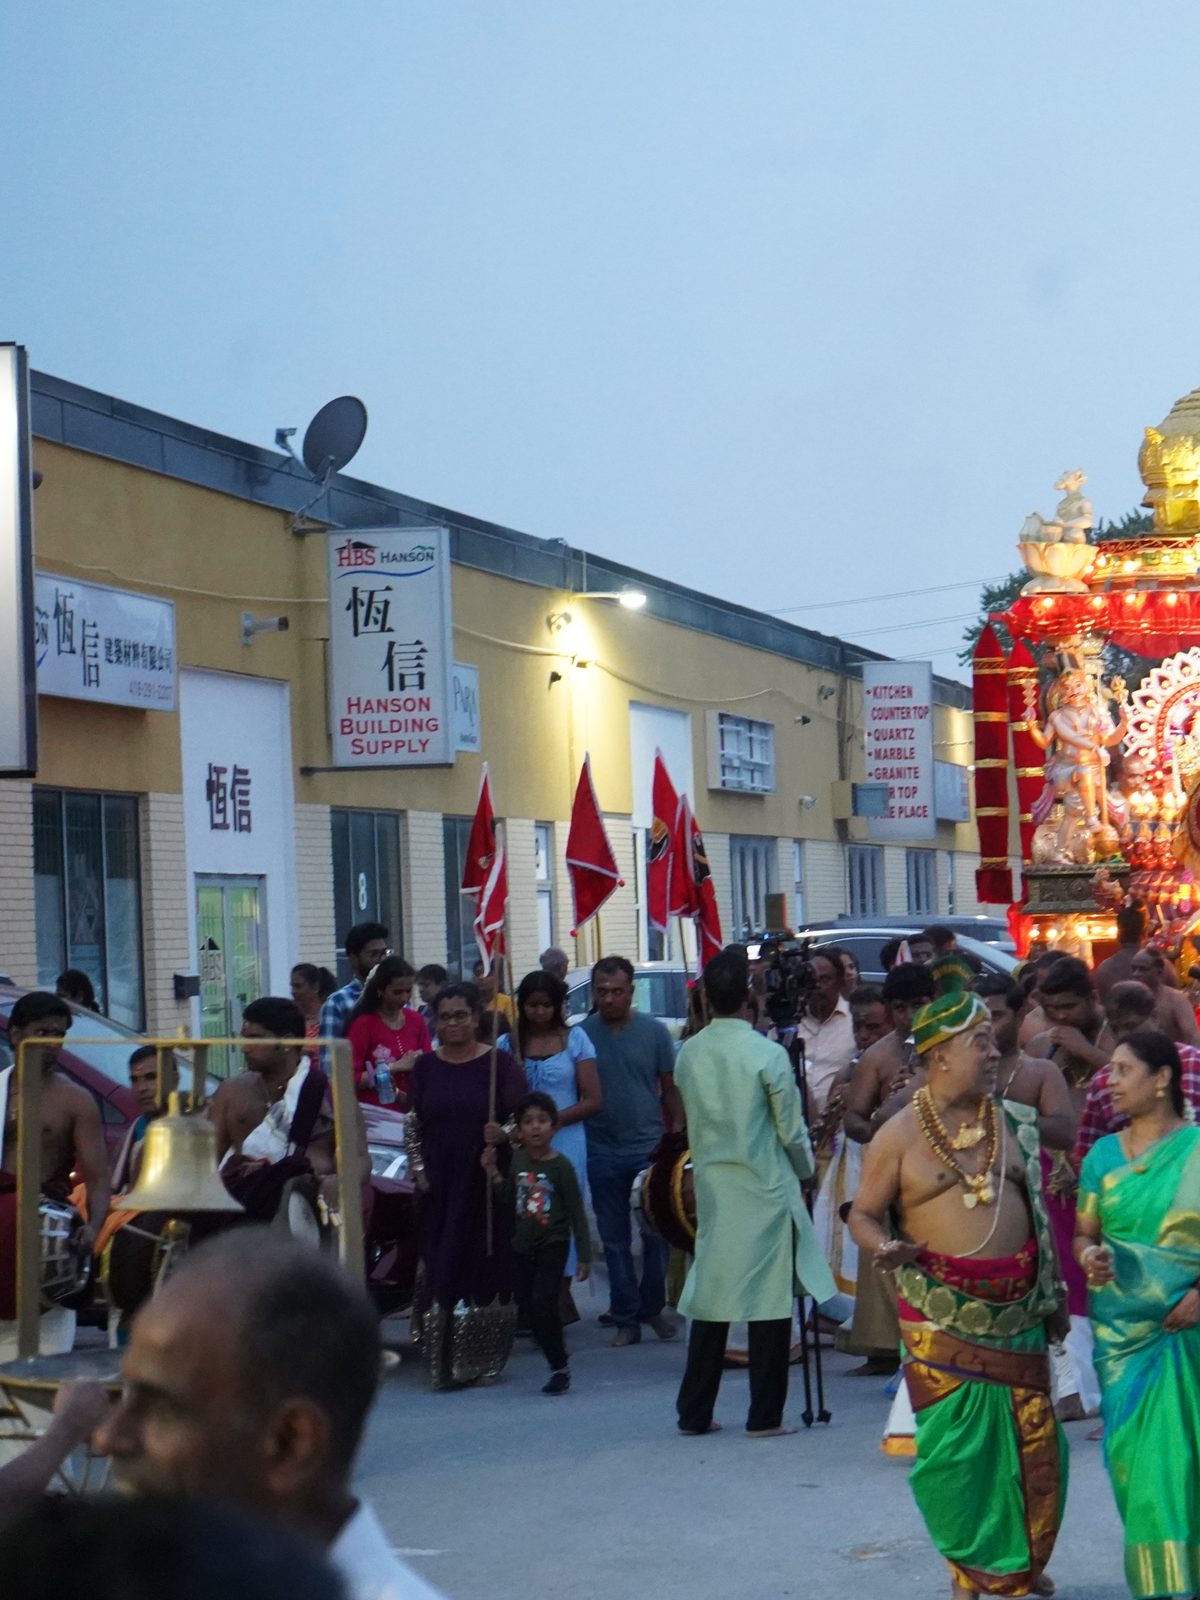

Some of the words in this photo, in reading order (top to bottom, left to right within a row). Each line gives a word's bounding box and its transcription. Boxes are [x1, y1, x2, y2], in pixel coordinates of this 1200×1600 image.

[338, 538, 376, 567] HBS
[380, 551, 434, 563] HANSON
[872, 684, 913, 699] KITCHEN
[346, 696, 432, 714] HANSON
[340, 717, 439, 735] BUILDING
[873, 727, 915, 741] QUARTZ
[351, 738, 430, 755] SUPPLY
[874, 747, 915, 760] MARBLE
[874, 766, 920, 780] GRANITE
[897, 786, 918, 799] TOP
[898, 805, 928, 819] PLACE
[358, 872, 367, 910] 8
